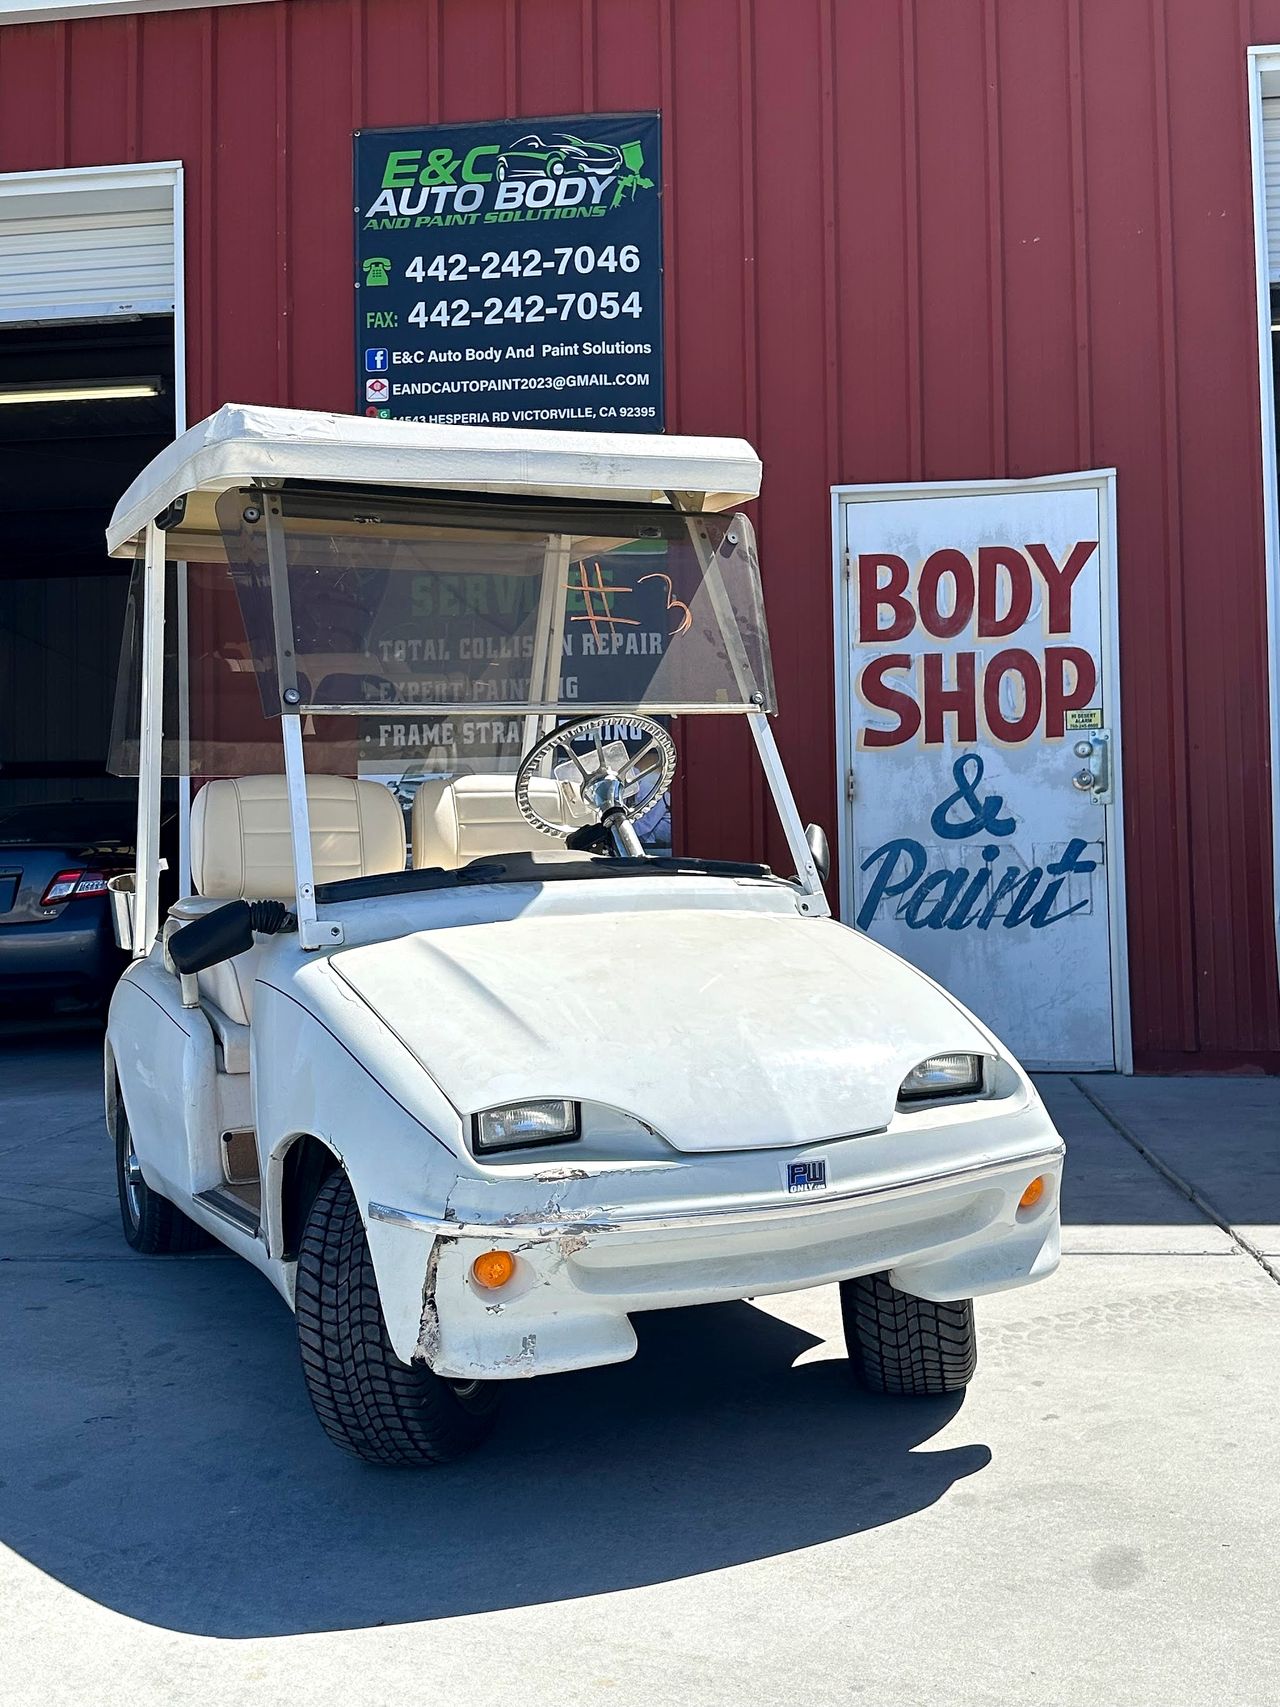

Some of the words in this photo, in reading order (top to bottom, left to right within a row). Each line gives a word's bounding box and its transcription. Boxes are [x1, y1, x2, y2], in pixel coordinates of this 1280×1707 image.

[381, 144, 500, 188] E&C
[364, 183, 485, 218] AUTO
[494, 175, 617, 210] BODY
[362, 217, 412, 231] AND
[414, 213, 481, 228] PAINT
[483, 205, 608, 224] SOLUTIONS
[404, 244, 641, 283] 442-242-7046
[366, 311, 399, 329] FAX:
[407, 291, 643, 328] 442-242-7054
[392, 350, 425, 365] E&C
[427, 350, 462, 363] Auto
[465, 346, 502, 363] Body
[505, 344, 535, 359] And
[542, 342, 580, 357] Paint
[582, 340, 652, 355] Solutions
[392, 373, 650, 396] EANDCAUTOPAINT2023@GMAIL.COM
[429, 413, 490, 425] HESPERIA
[492, 411, 510, 423] RD
[512, 407, 597, 421] VICTORVILLE,
[599, 406, 617, 418] CA
[619, 406, 656, 418] 92395
[411, 570, 615, 617] SERVIES
[857, 541, 1098, 643] BODY
[378, 637, 450, 662] TOTAL
[458, 633, 573, 660] COLLISN
[581, 632, 663, 656] REPAIR
[379, 680, 465, 702] EXPERT
[860, 647, 1097, 747] SHOP
[379, 722, 455, 747] FRAME
[930, 752, 1017, 840] &
[856, 837, 1097, 932] Paint
